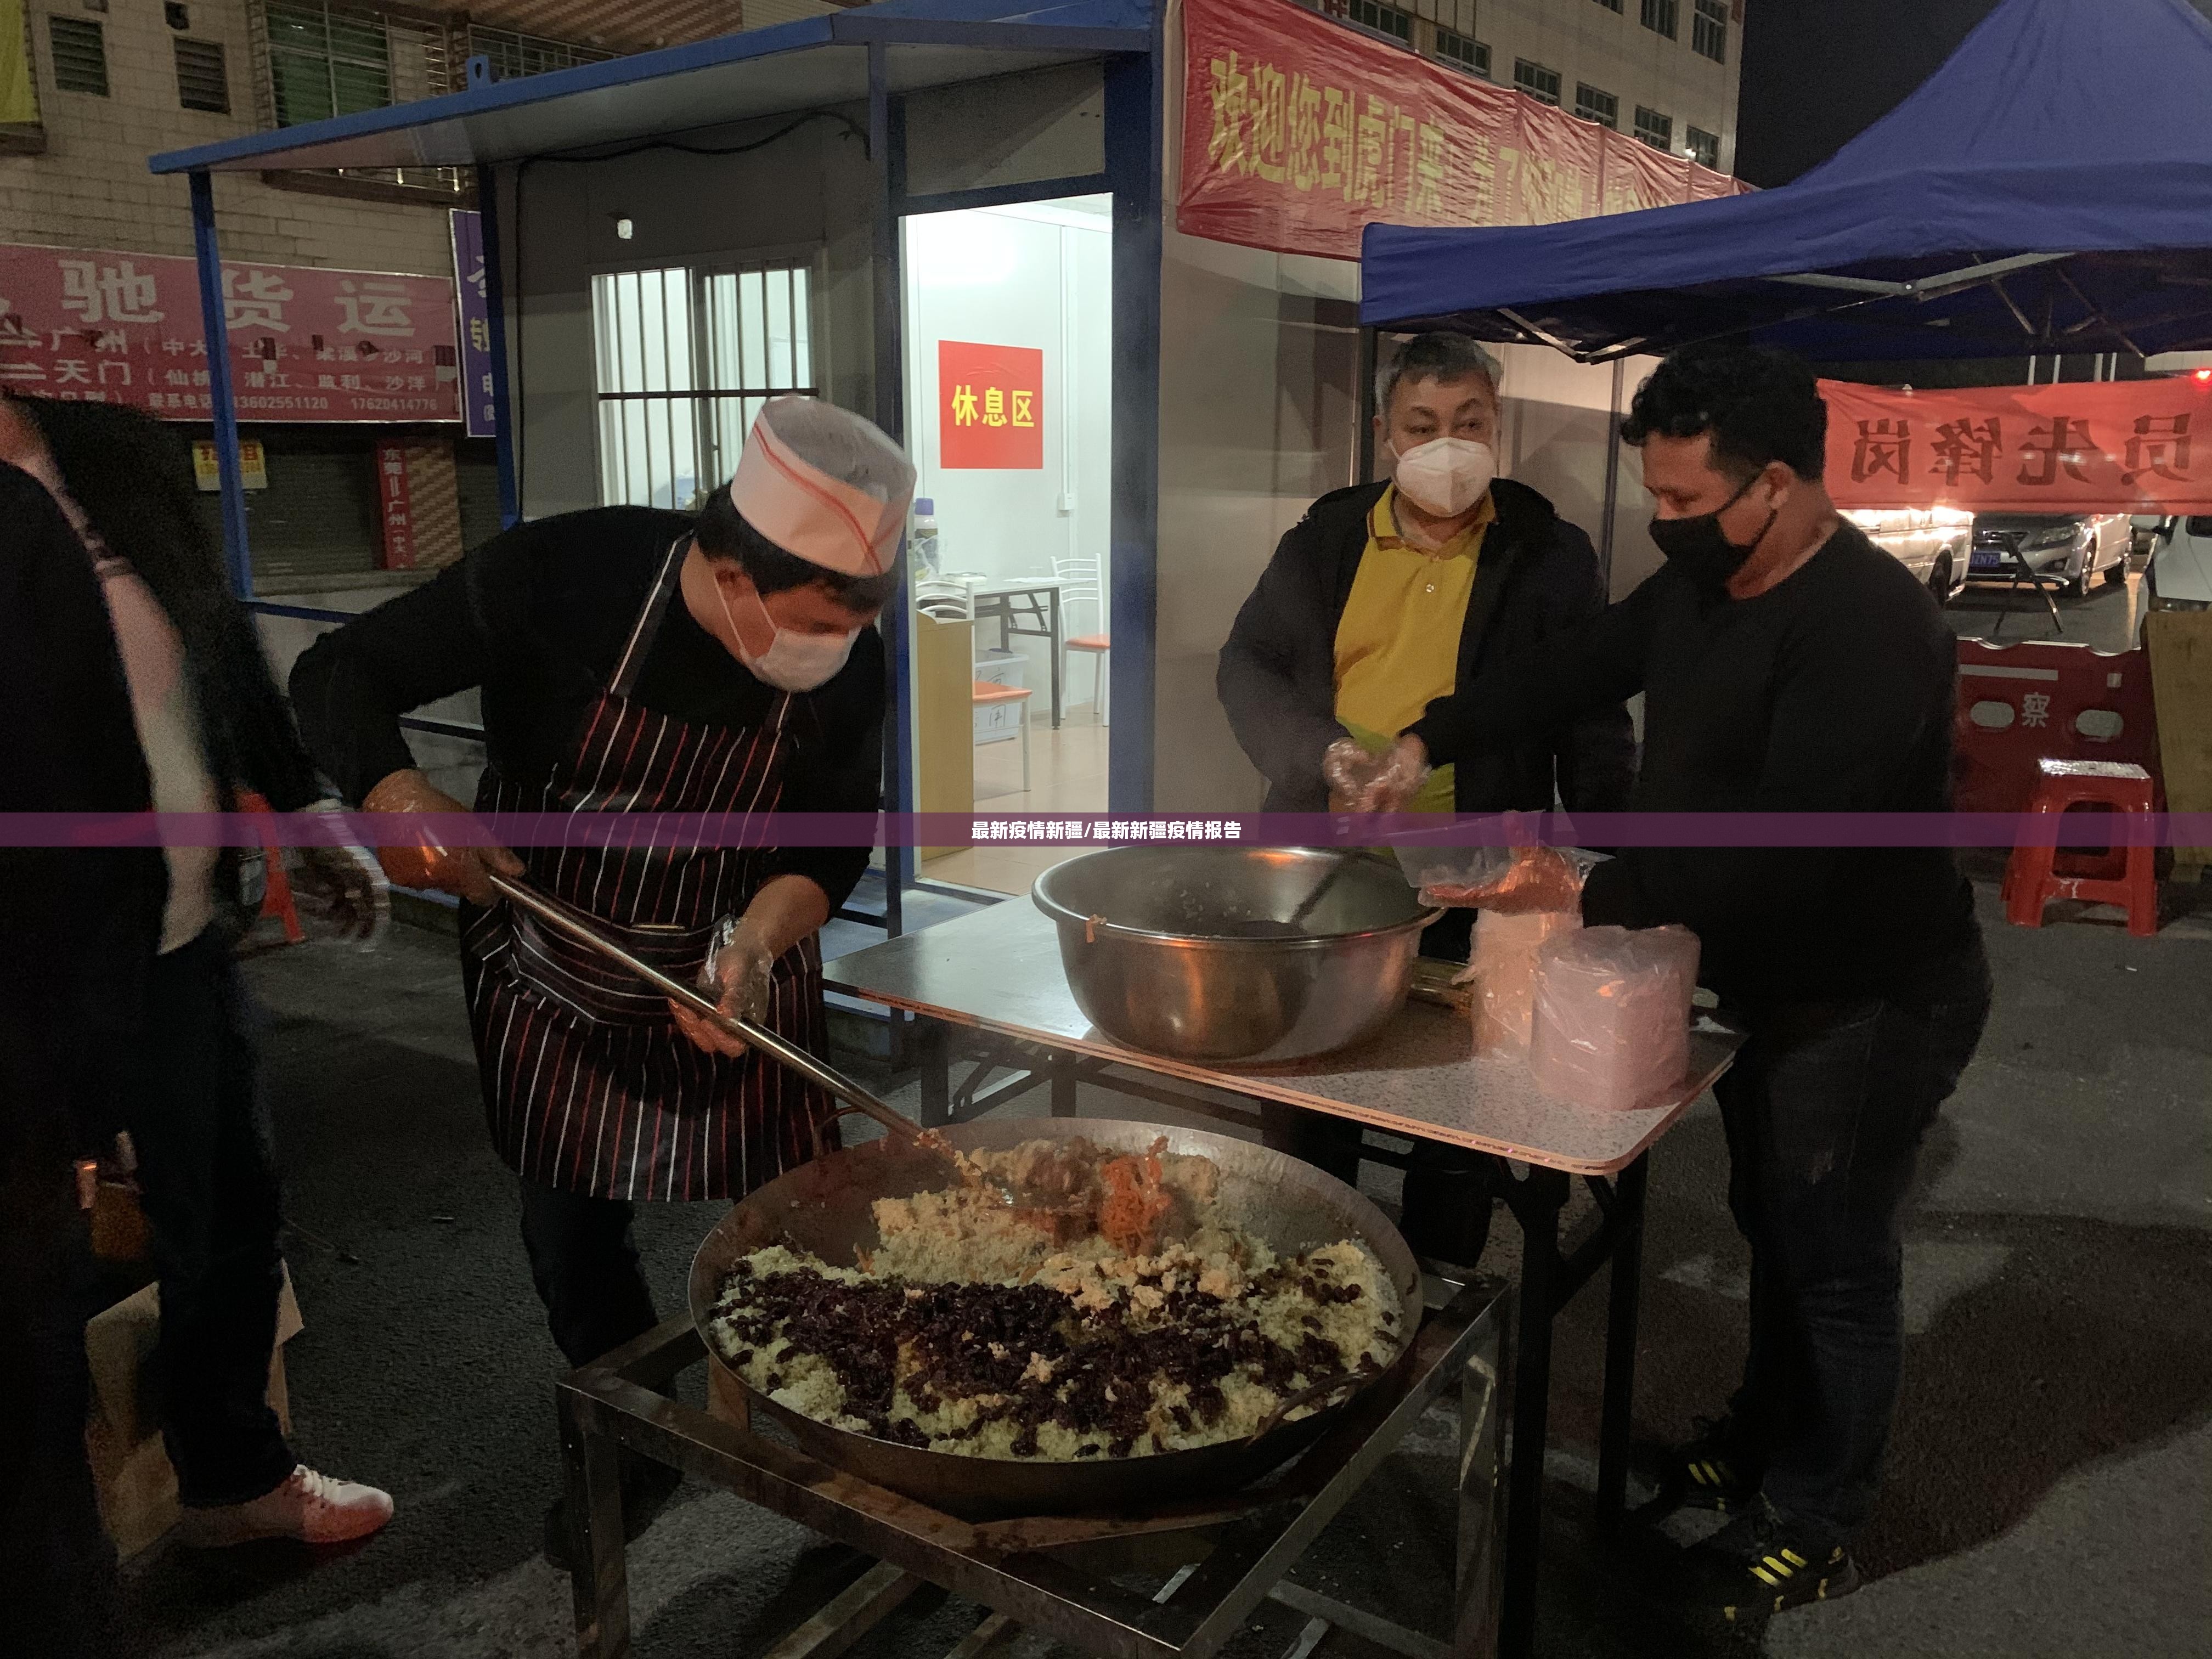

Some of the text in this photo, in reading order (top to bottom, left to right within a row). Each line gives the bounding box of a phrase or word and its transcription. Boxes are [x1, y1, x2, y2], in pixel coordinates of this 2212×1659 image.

[0, 260, 415, 337] 驰货运
[54, 359, 132, 385] 天门
[951, 385, 1035, 427] 休息区
[2022, 692, 2050, 729] 察
